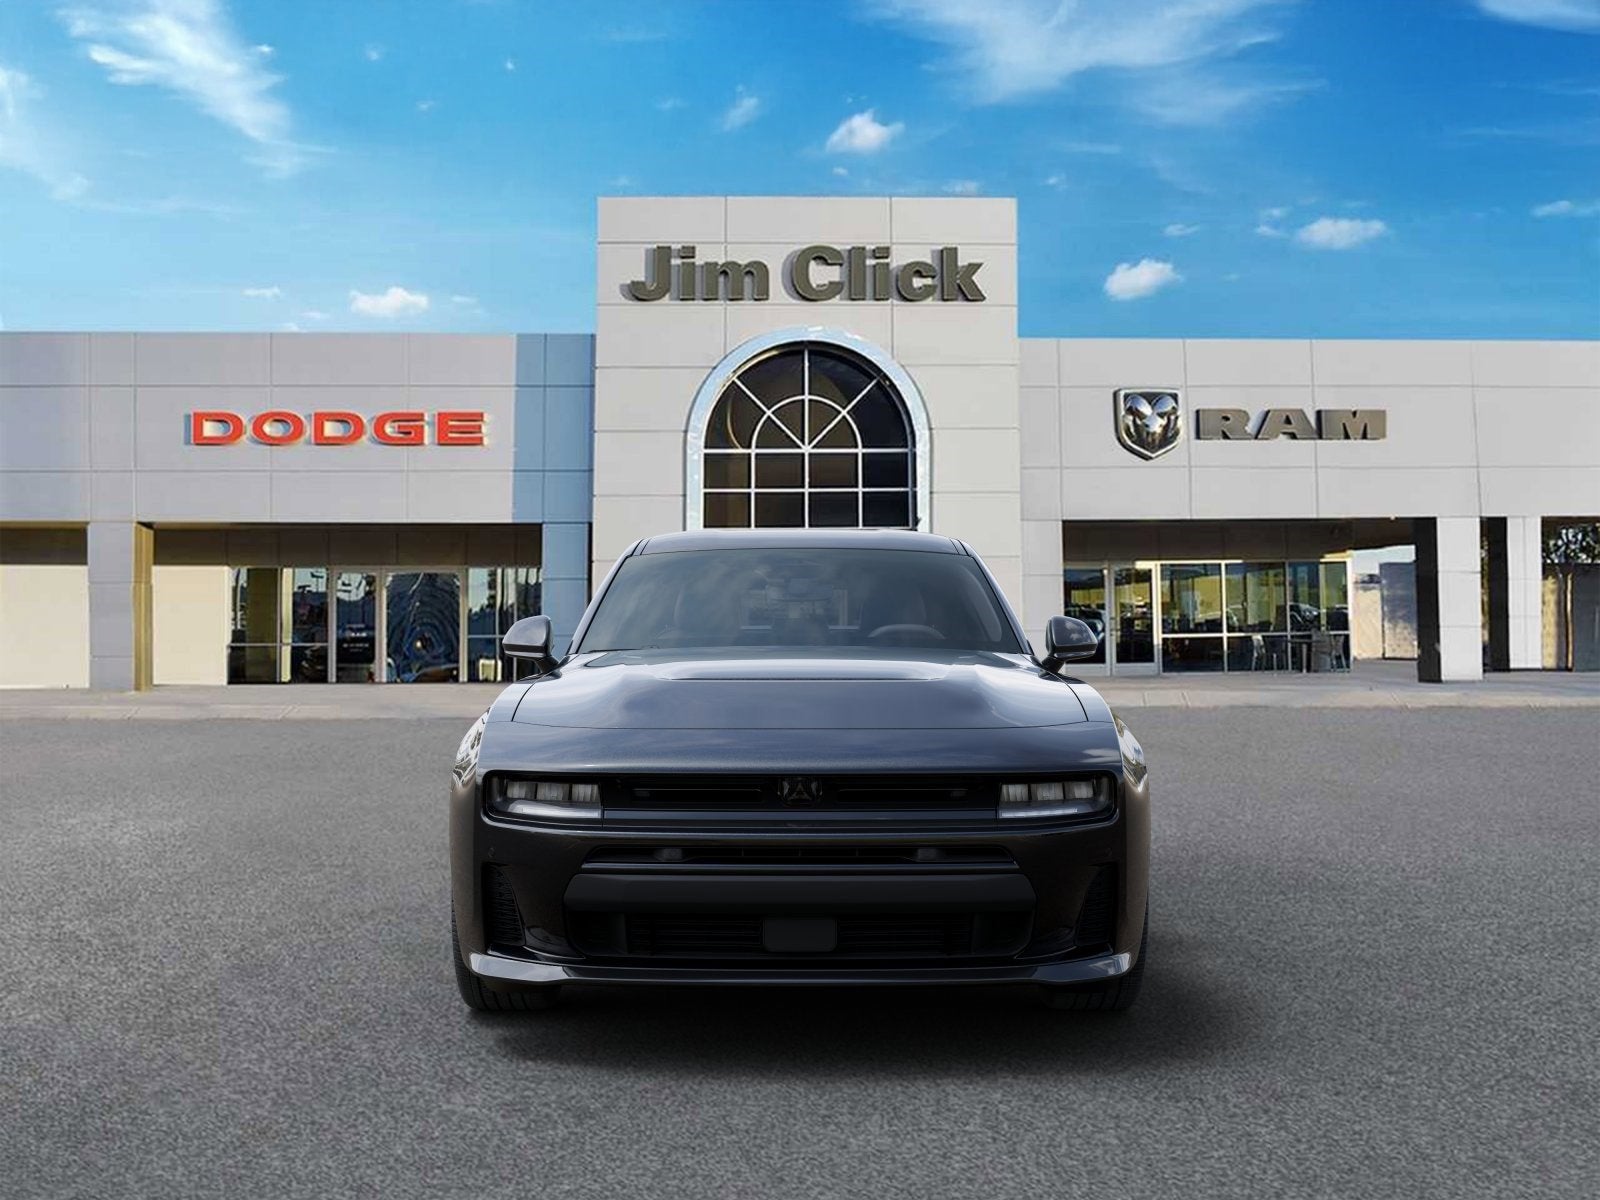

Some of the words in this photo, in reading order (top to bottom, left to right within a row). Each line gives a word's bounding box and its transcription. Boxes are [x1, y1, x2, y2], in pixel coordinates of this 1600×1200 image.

[627, 245, 770, 301] Jim
[791, 245, 986, 302] Click
[190, 410, 486, 446] DODGE
[1195, 408, 1387, 440] RAM
